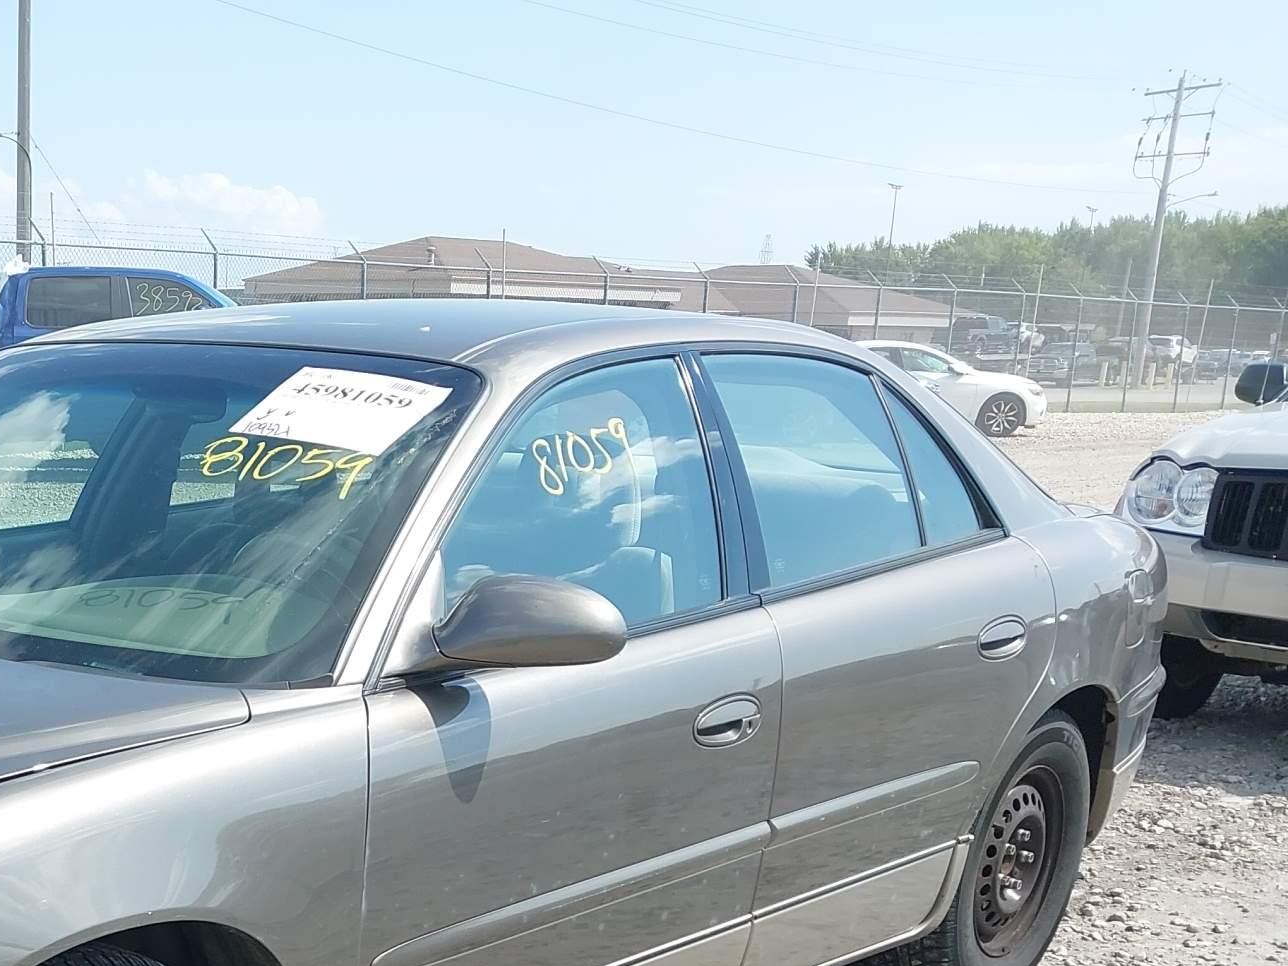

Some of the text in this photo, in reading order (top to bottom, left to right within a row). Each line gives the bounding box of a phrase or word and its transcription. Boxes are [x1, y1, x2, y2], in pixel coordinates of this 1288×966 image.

[292, 382, 413, 409] 45981059
[200, 436, 375, 500] 81059
[531, 416, 638, 497] 81059
